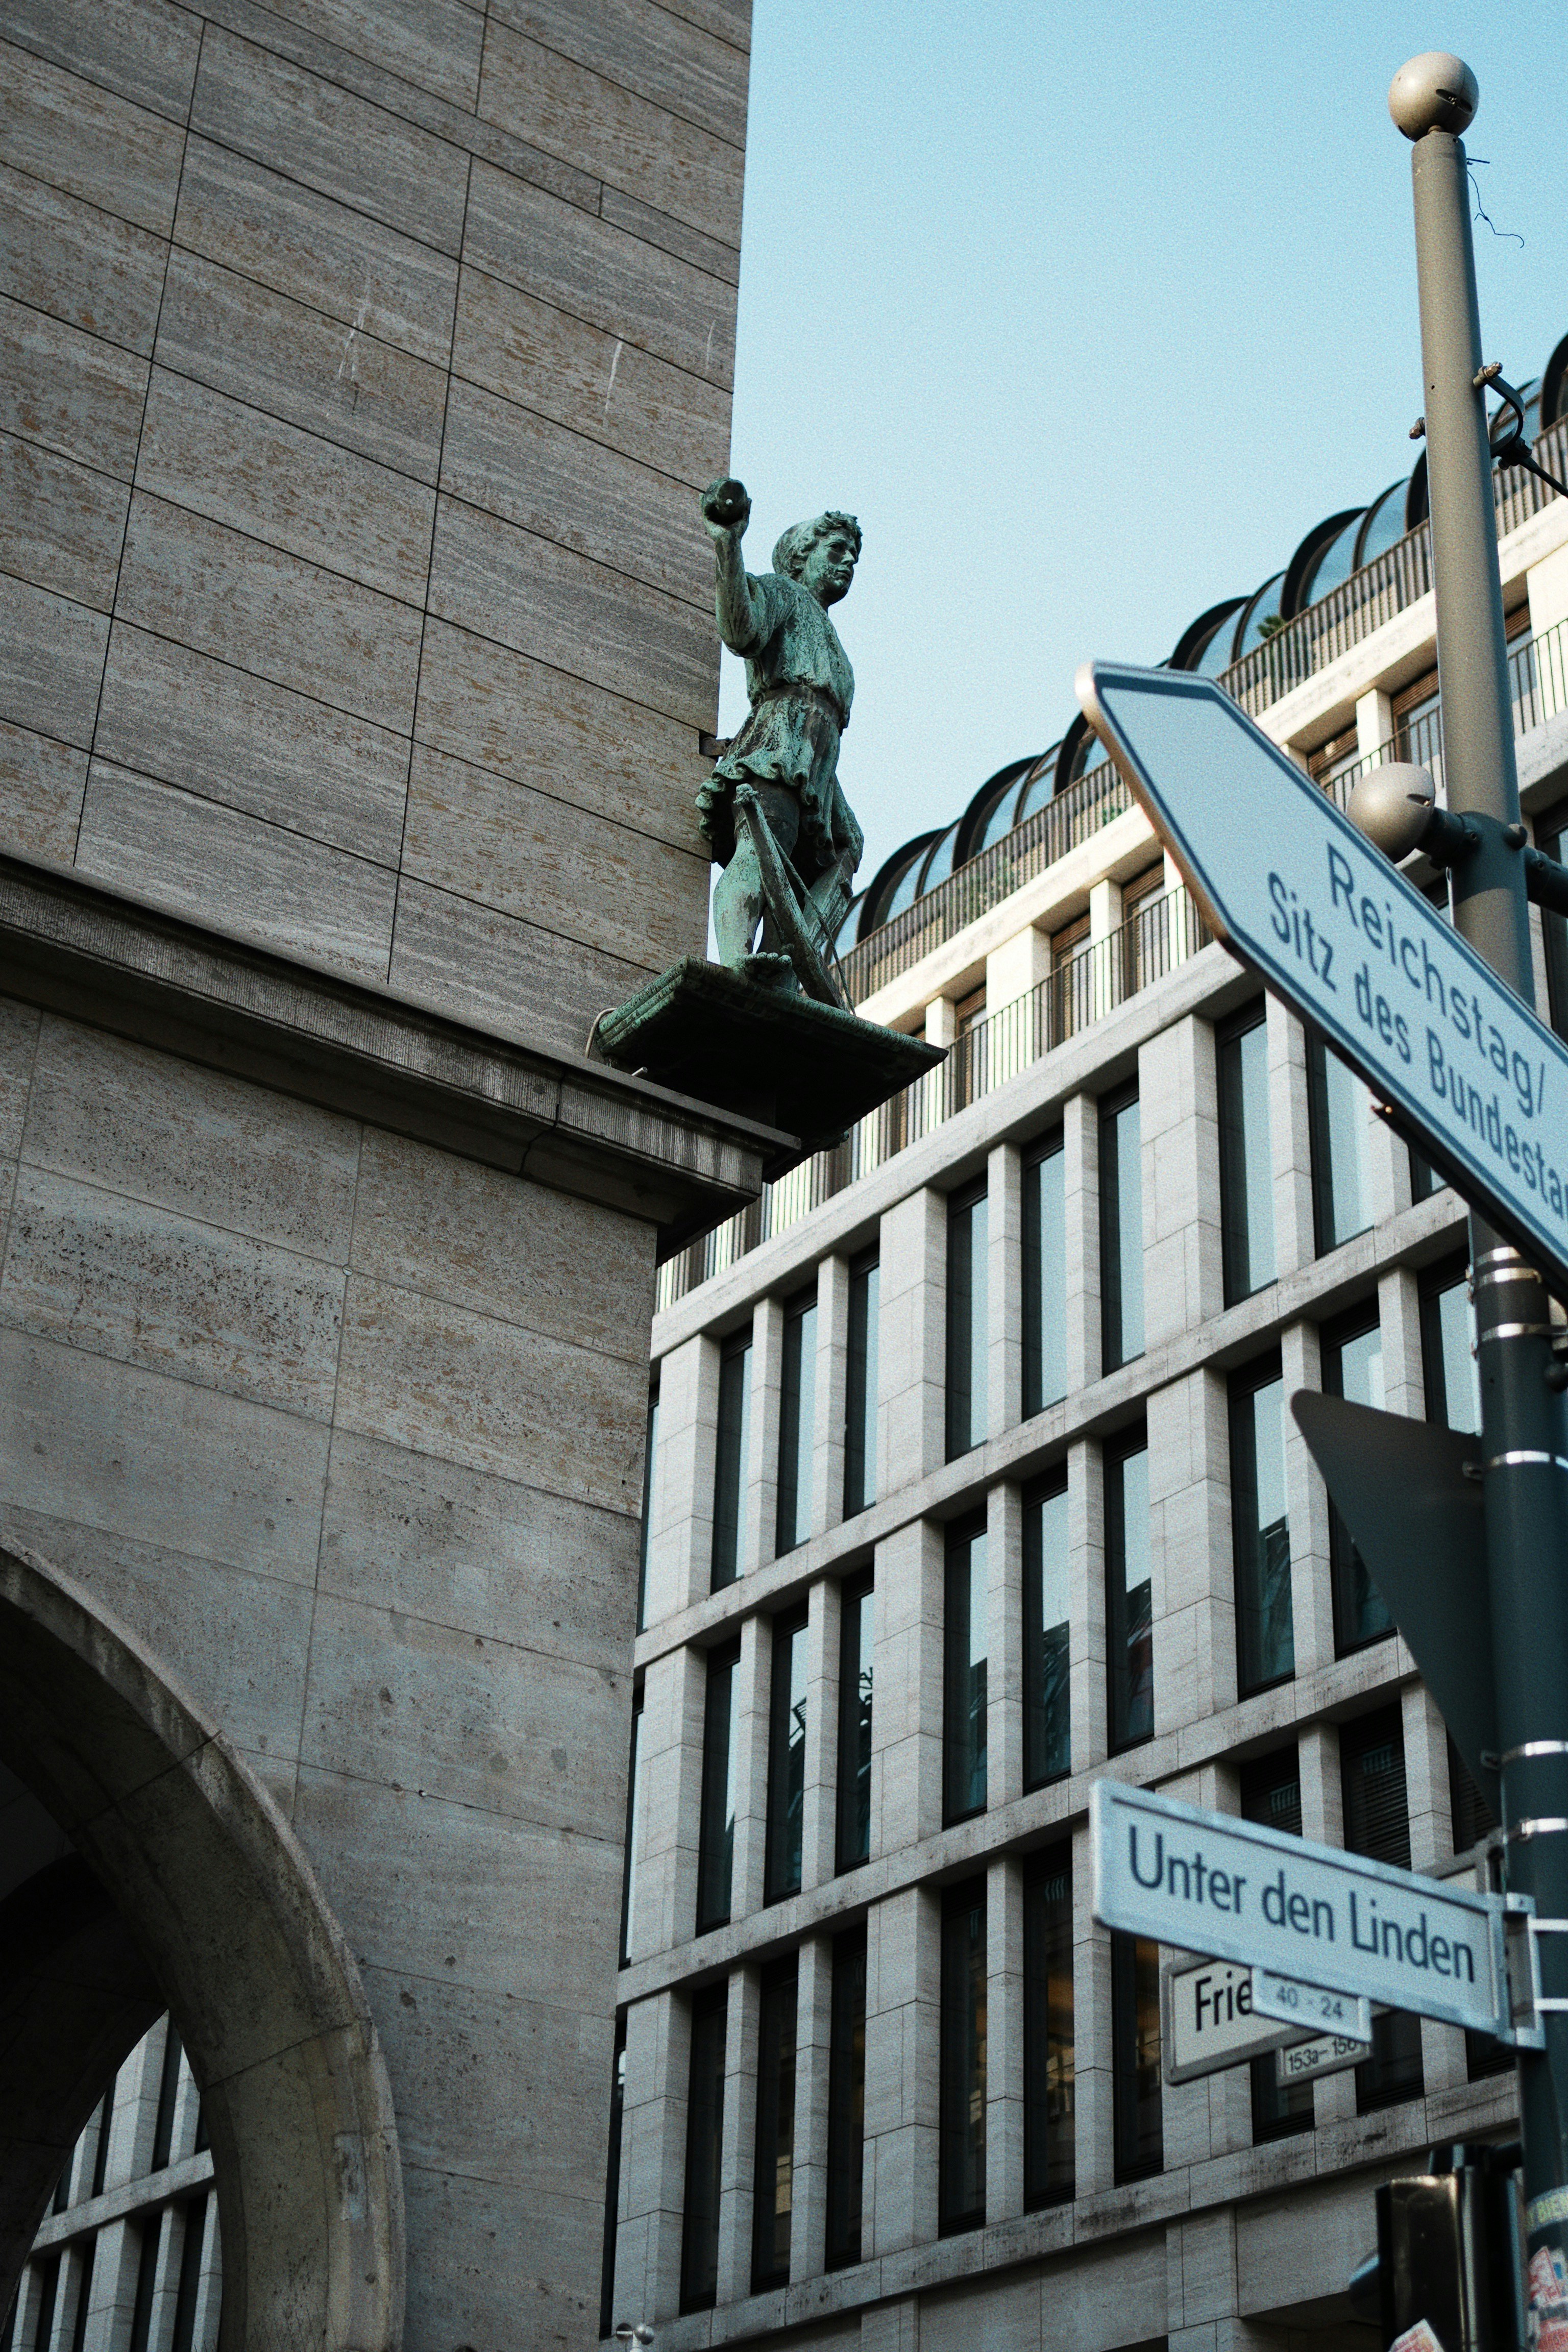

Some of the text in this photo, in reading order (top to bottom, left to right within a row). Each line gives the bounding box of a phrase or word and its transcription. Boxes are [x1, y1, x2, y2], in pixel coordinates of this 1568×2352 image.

[1267, 871, 1336, 994] Sitz
[1354, 961, 1411, 1065] des
[1327, 841, 1545, 1118] Reichstag/
[1129, 1824, 1474, 1983] Unter den Linden
[1277, 1986, 1298, 2008] 40
[1320, 1995, 1344, 2019] 24
